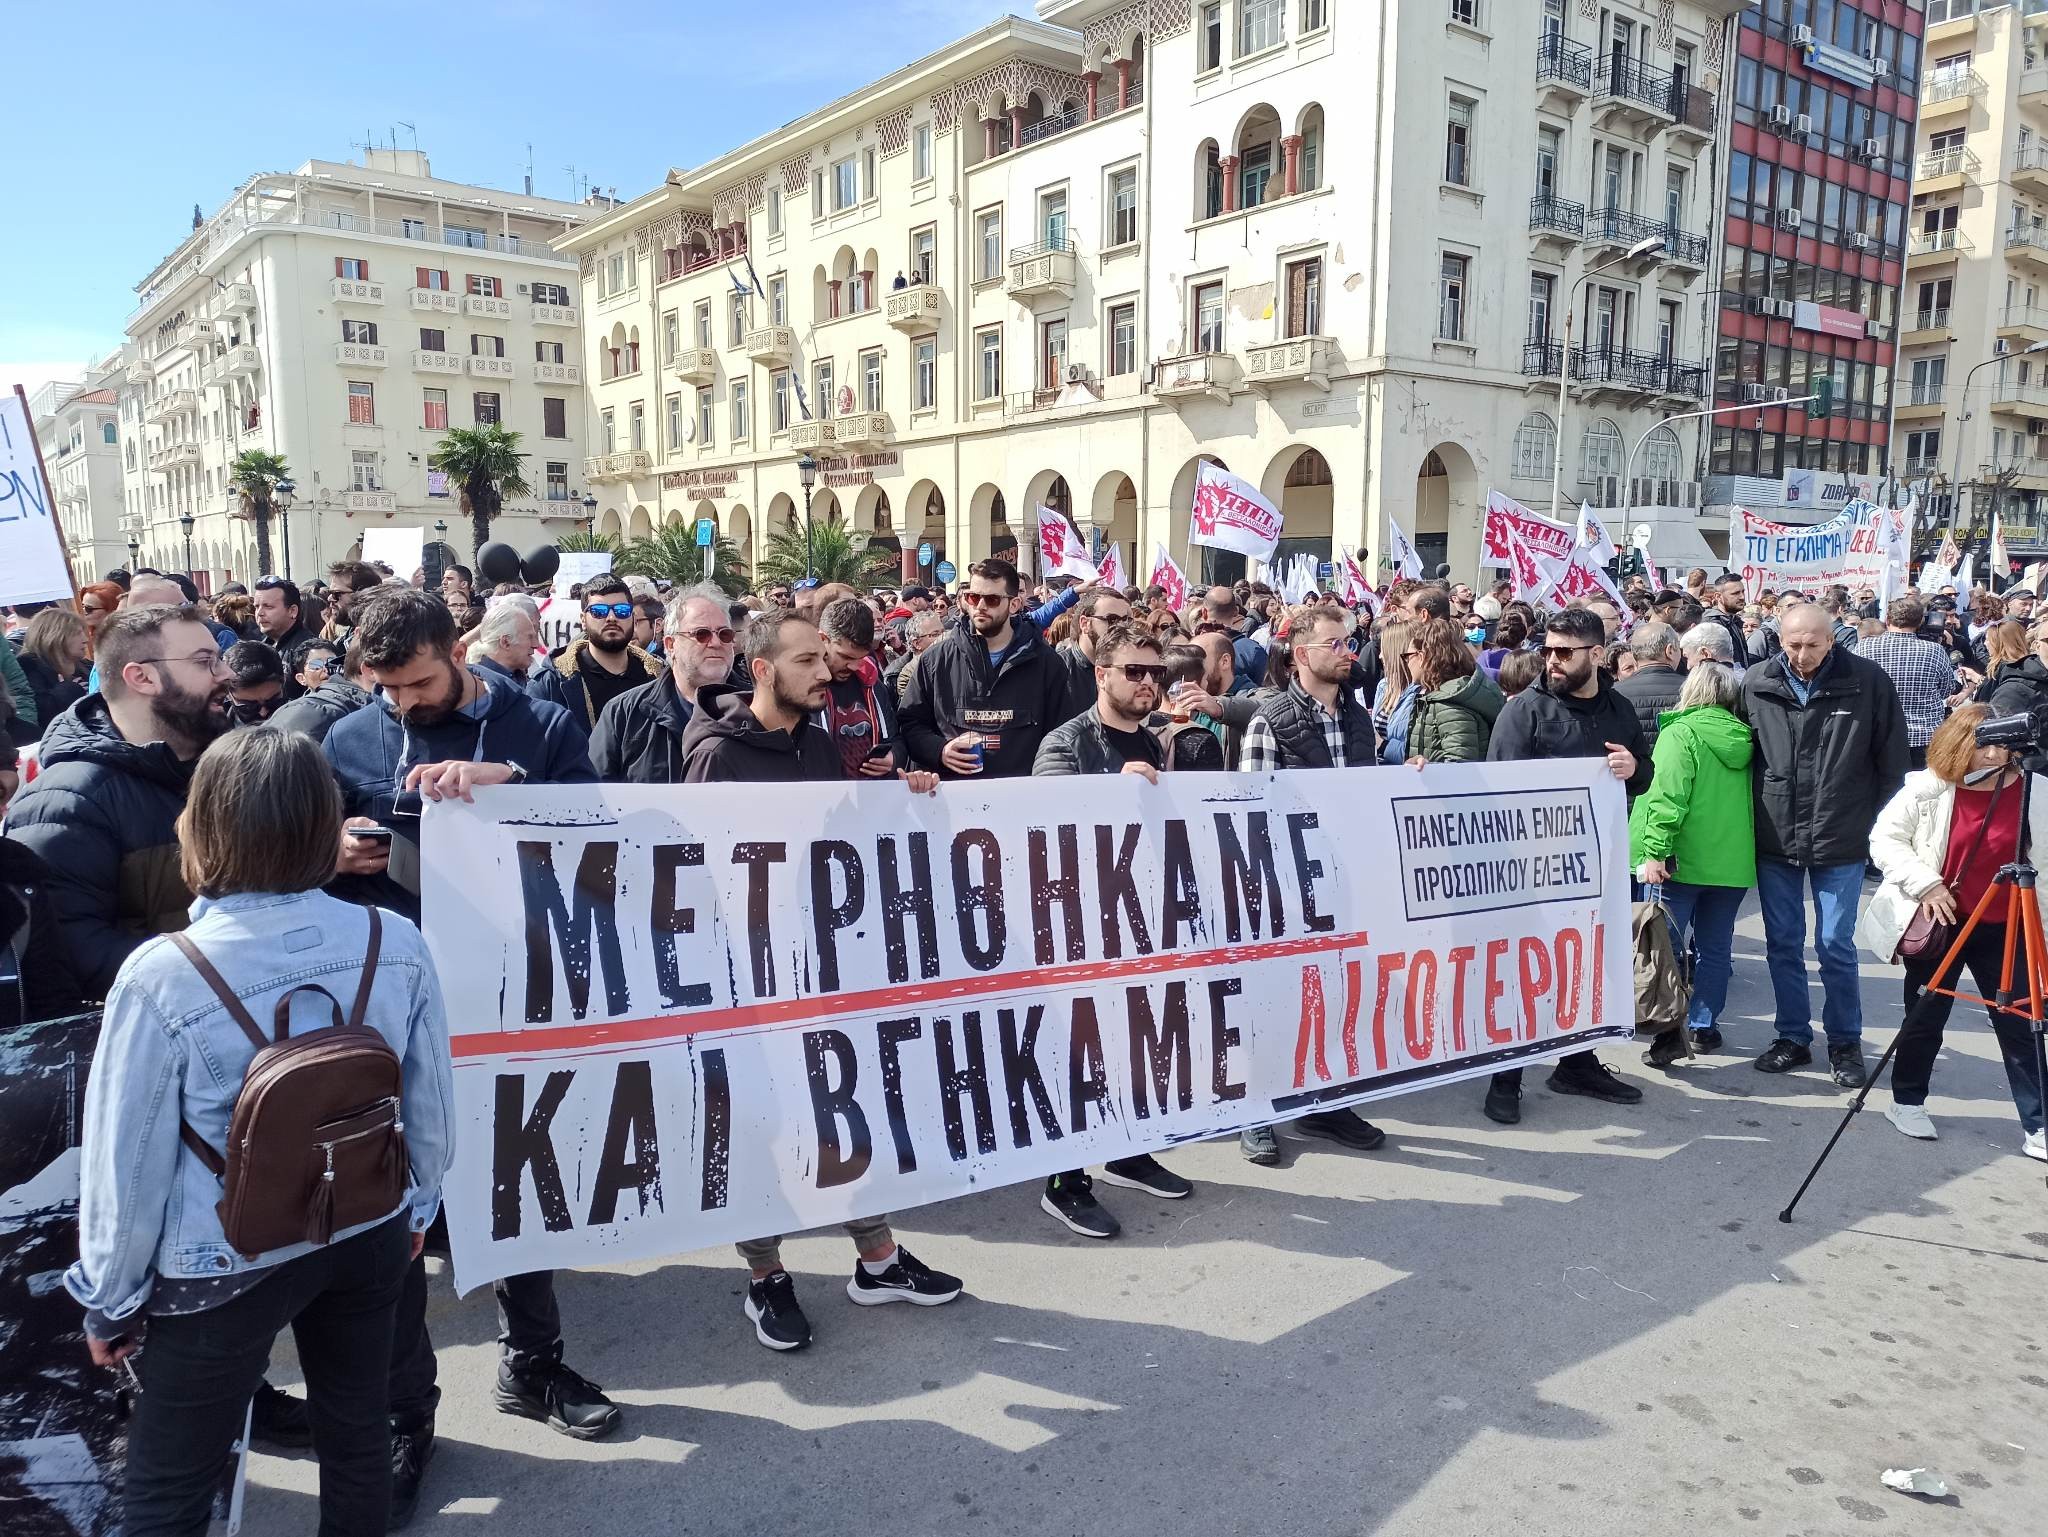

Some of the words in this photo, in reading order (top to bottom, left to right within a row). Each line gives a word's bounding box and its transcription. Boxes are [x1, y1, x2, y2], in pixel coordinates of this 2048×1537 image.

[1745, 536, 1768, 562] ΤΟ
[1776, 532, 1842, 563] ΕΓΚΛΗΜΑ
[1404, 808, 1528, 850] ΠΑΝΕΛΛΗΝΙΑ
[1532, 804, 1586, 839] ΕΝΩΣΗ
[1413, 857, 1528, 902] ΠΡΟΣΩΠΙΚΟΥ
[1533, 852, 1590, 888] ΕΛΞΗΣ
[516, 811, 1335, 1024] ΜΕΤΡΗΘΗΚΑΜΕ
[491, 1048, 732, 1241] ΚΑΙ
[802, 977, 1246, 1189] ΒΓΗΚΑΜΕ
[1292, 918, 1605, 1089] ΛΙΓΟΤΕΡΟΙ
